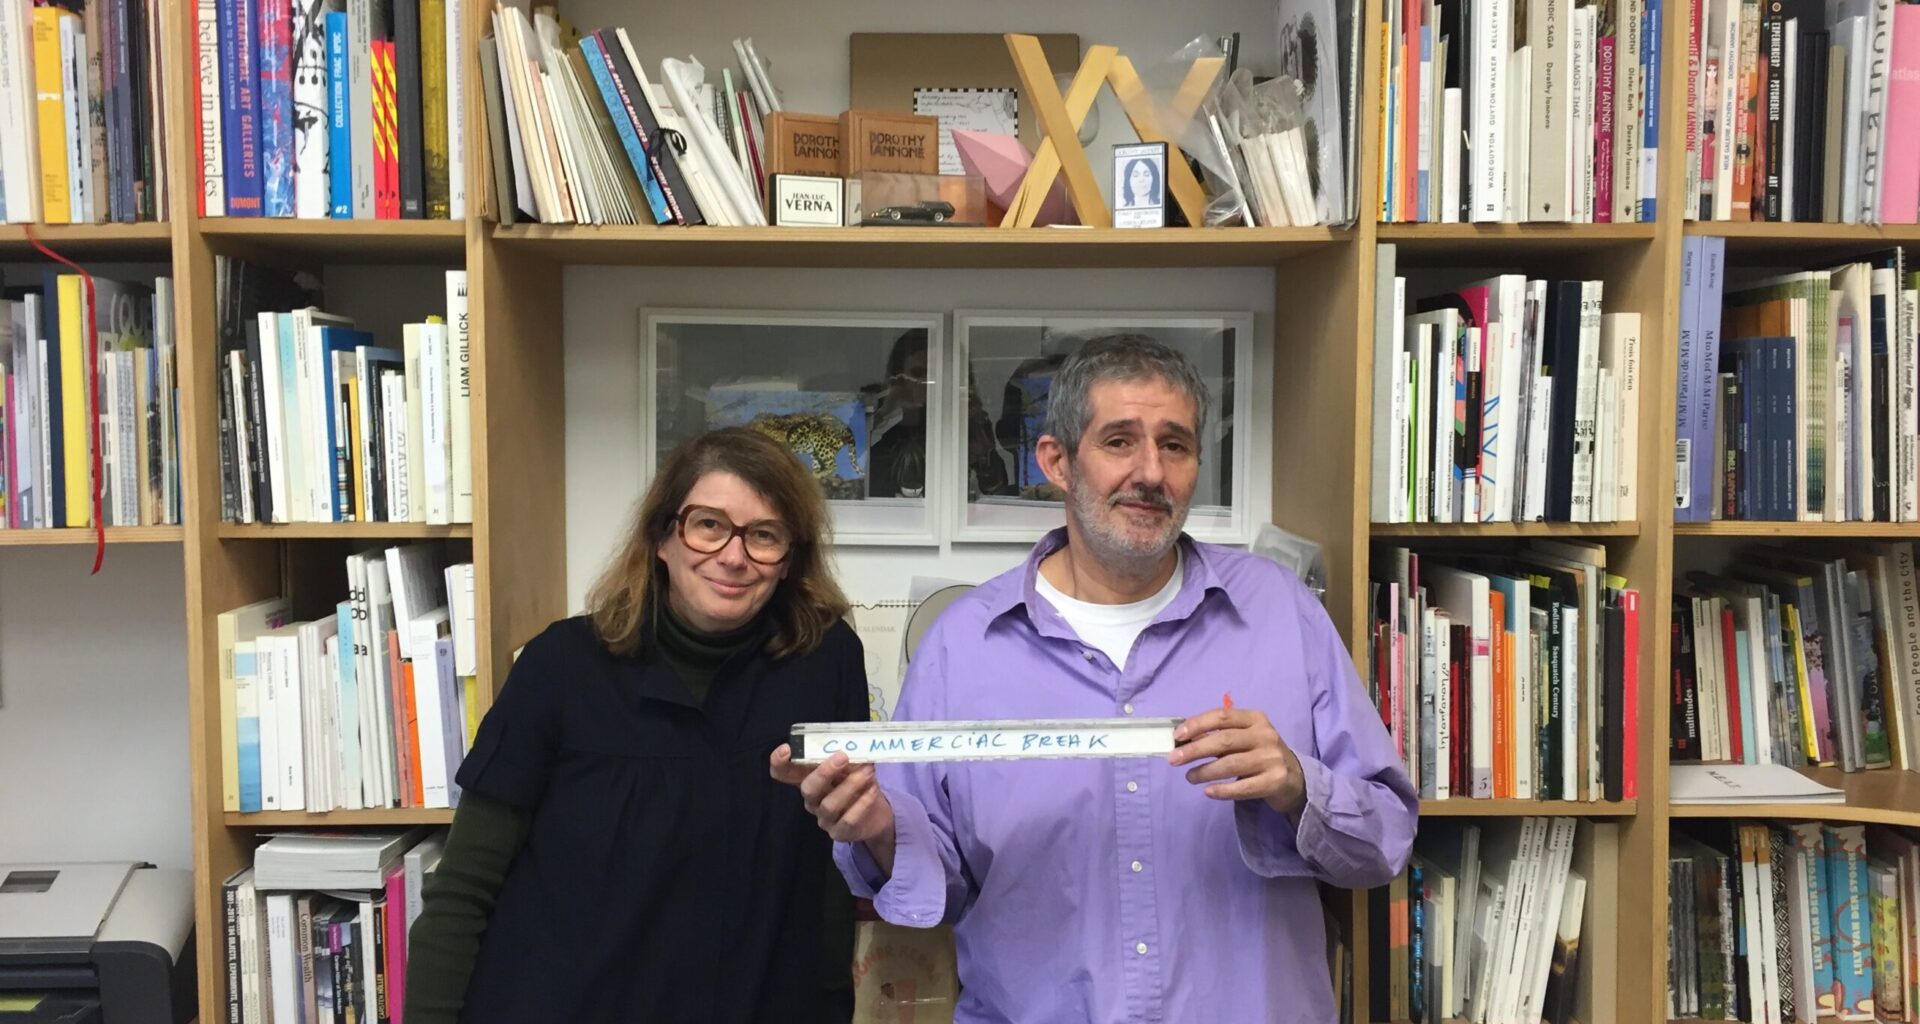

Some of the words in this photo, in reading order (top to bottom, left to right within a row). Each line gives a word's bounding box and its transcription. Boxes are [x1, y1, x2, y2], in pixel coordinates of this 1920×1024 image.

[1546, 25, 1554, 49] SAGA
[1628, 15, 1636, 55] DOROTHY
[1770, 22, 1781, 67] EXPERIENCED?
[198, 20, 217, 84] believe
[333, 57, 342, 78] FRAC
[1543, 62, 1553, 94] Dorothy
[1573, 53, 1582, 91] ALMOST
[1601, 45, 1611, 88] DOROTHY
[1627, 67, 1635, 91] Dieter
[240, 88, 252, 110] ART
[1687, 70, 1697, 108] Dorothy
[1769, 79, 1781, 121] PSYCHEDELIC
[202, 93, 219, 111] in
[334, 82, 344, 128] COLLECTION
[1544, 96, 1553, 129] Iannone
[1572, 95, 1581, 119] THAT
[1601, 91, 1611, 132] IANNONE
[1626, 93, 1634, 111] Roth
[793, 132, 840, 147] DOROTH
[869, 131, 925, 146] DOROTHY
[1624, 124, 1633, 156] Dorothy
[1686, 111, 1697, 152] IANNONE
[203, 120, 223, 197] miracles
[241, 115, 256, 179] GALLERIES
[793, 147, 840, 159] IANNON
[869, 146, 925, 159] IANNONE
[1768, 175, 1778, 188] ART
[785, 199, 833, 212] VERNA
[792, 192, 826, 200] JEAN-LUC
[335, 205, 349, 215] #2
[1685, 251, 1694, 267] King
[458, 312, 470, 362] GILLICK
[1627, 336, 1636, 358] Trois
[1682, 329, 1691, 340] M
[1704, 330, 1714, 340] M
[1627, 359, 1635, 371] fois
[1680, 360, 1689, 371] de
[1681, 348, 1690, 359] M
[1704, 349, 1713, 359] M
[460, 366, 471, 397] LIAM
[1899, 551, 1911, 577] City
[1902, 581, 1913, 600] the
[1551, 602, 1560, 635] Rødland
[1904, 605, 1916, 628] and
[1550, 646, 1560, 685] Sasquatch
[1908, 632, 1920, 675] People
[1550, 687, 1560, 719] Century
[1684, 688, 1696, 738] multitudes
[1021, 733, 1109, 752] BREAK
[1808, 890, 1818, 915] DER
[1849, 895, 1860, 920] DER
[227, 925, 236, 936] 104
[300, 913, 311, 952] Common
[1810, 917, 1820, 942] VAN
[1851, 921, 1861, 947] VAN
[302, 953, 313, 983] Wealth
[1813, 944, 1824, 970] LILY
[1853, 950, 1864, 976] LILY
[376, 974, 384, 994] HÖLLER
[230, 1003, 239, 1024] EVENTS
[377, 994, 385, 1019] CARSTEN
